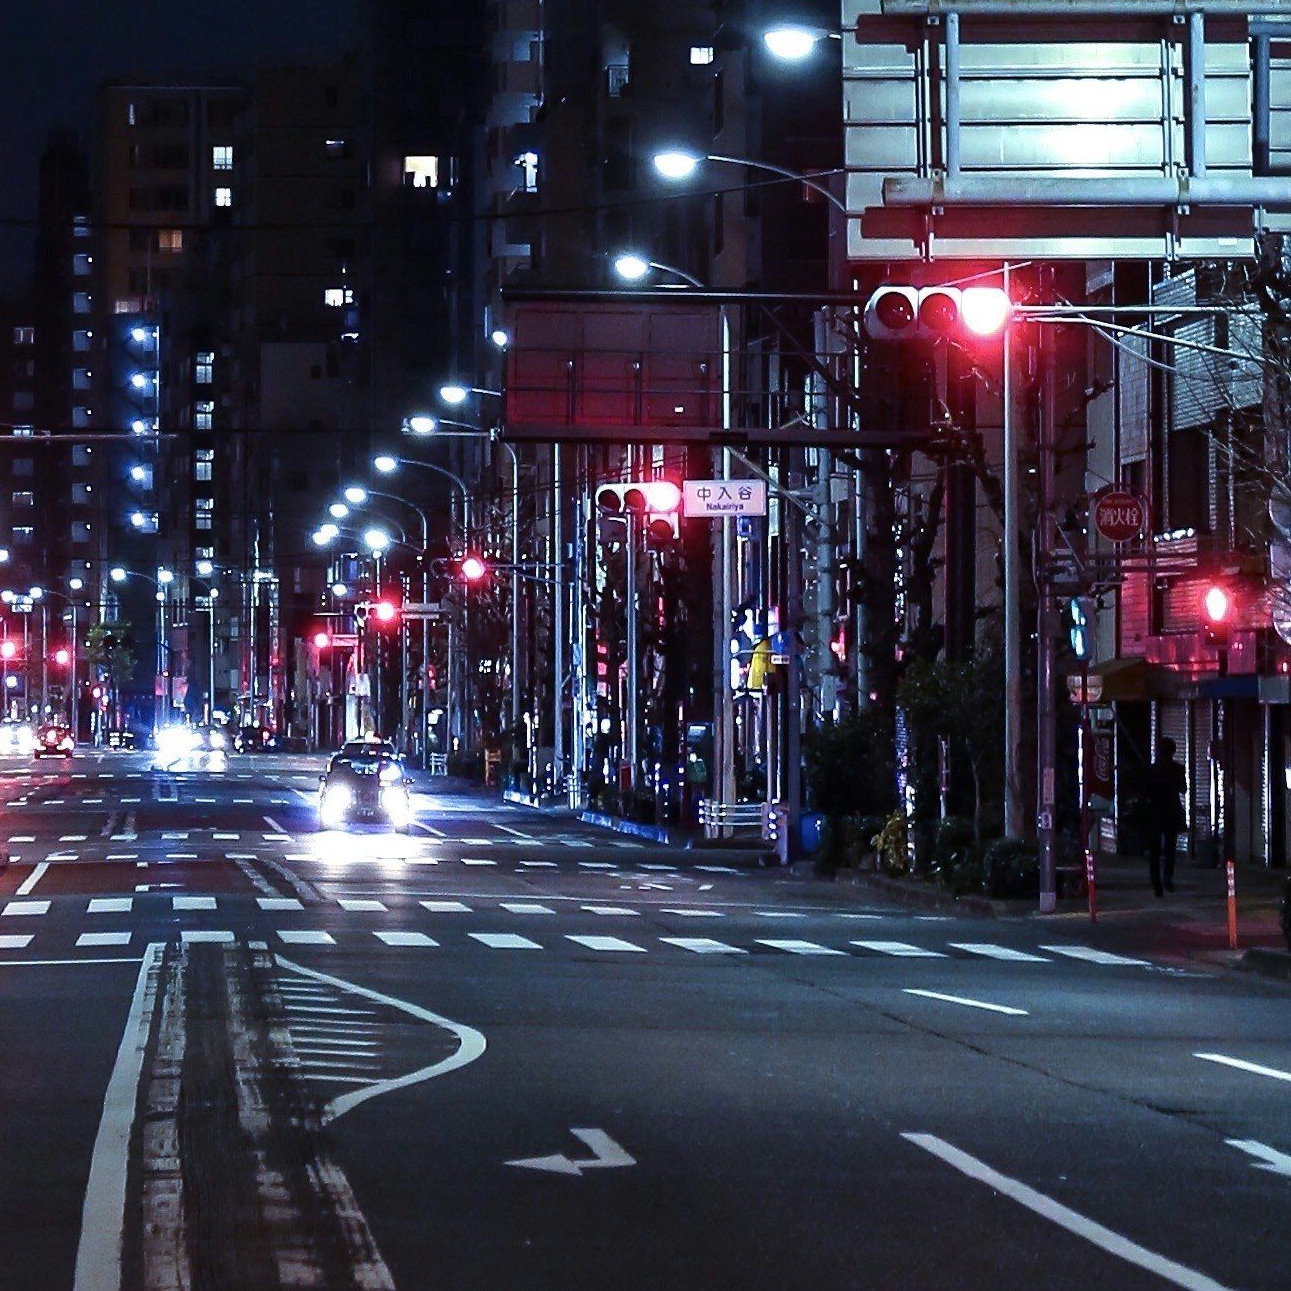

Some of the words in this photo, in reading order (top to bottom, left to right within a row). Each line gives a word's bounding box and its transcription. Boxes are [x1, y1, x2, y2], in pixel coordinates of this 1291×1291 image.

[697, 485, 752, 501] 中入谷
[706, 503, 744, 511] Nakairiya
[1099, 507, 1139, 526] 消火栓
